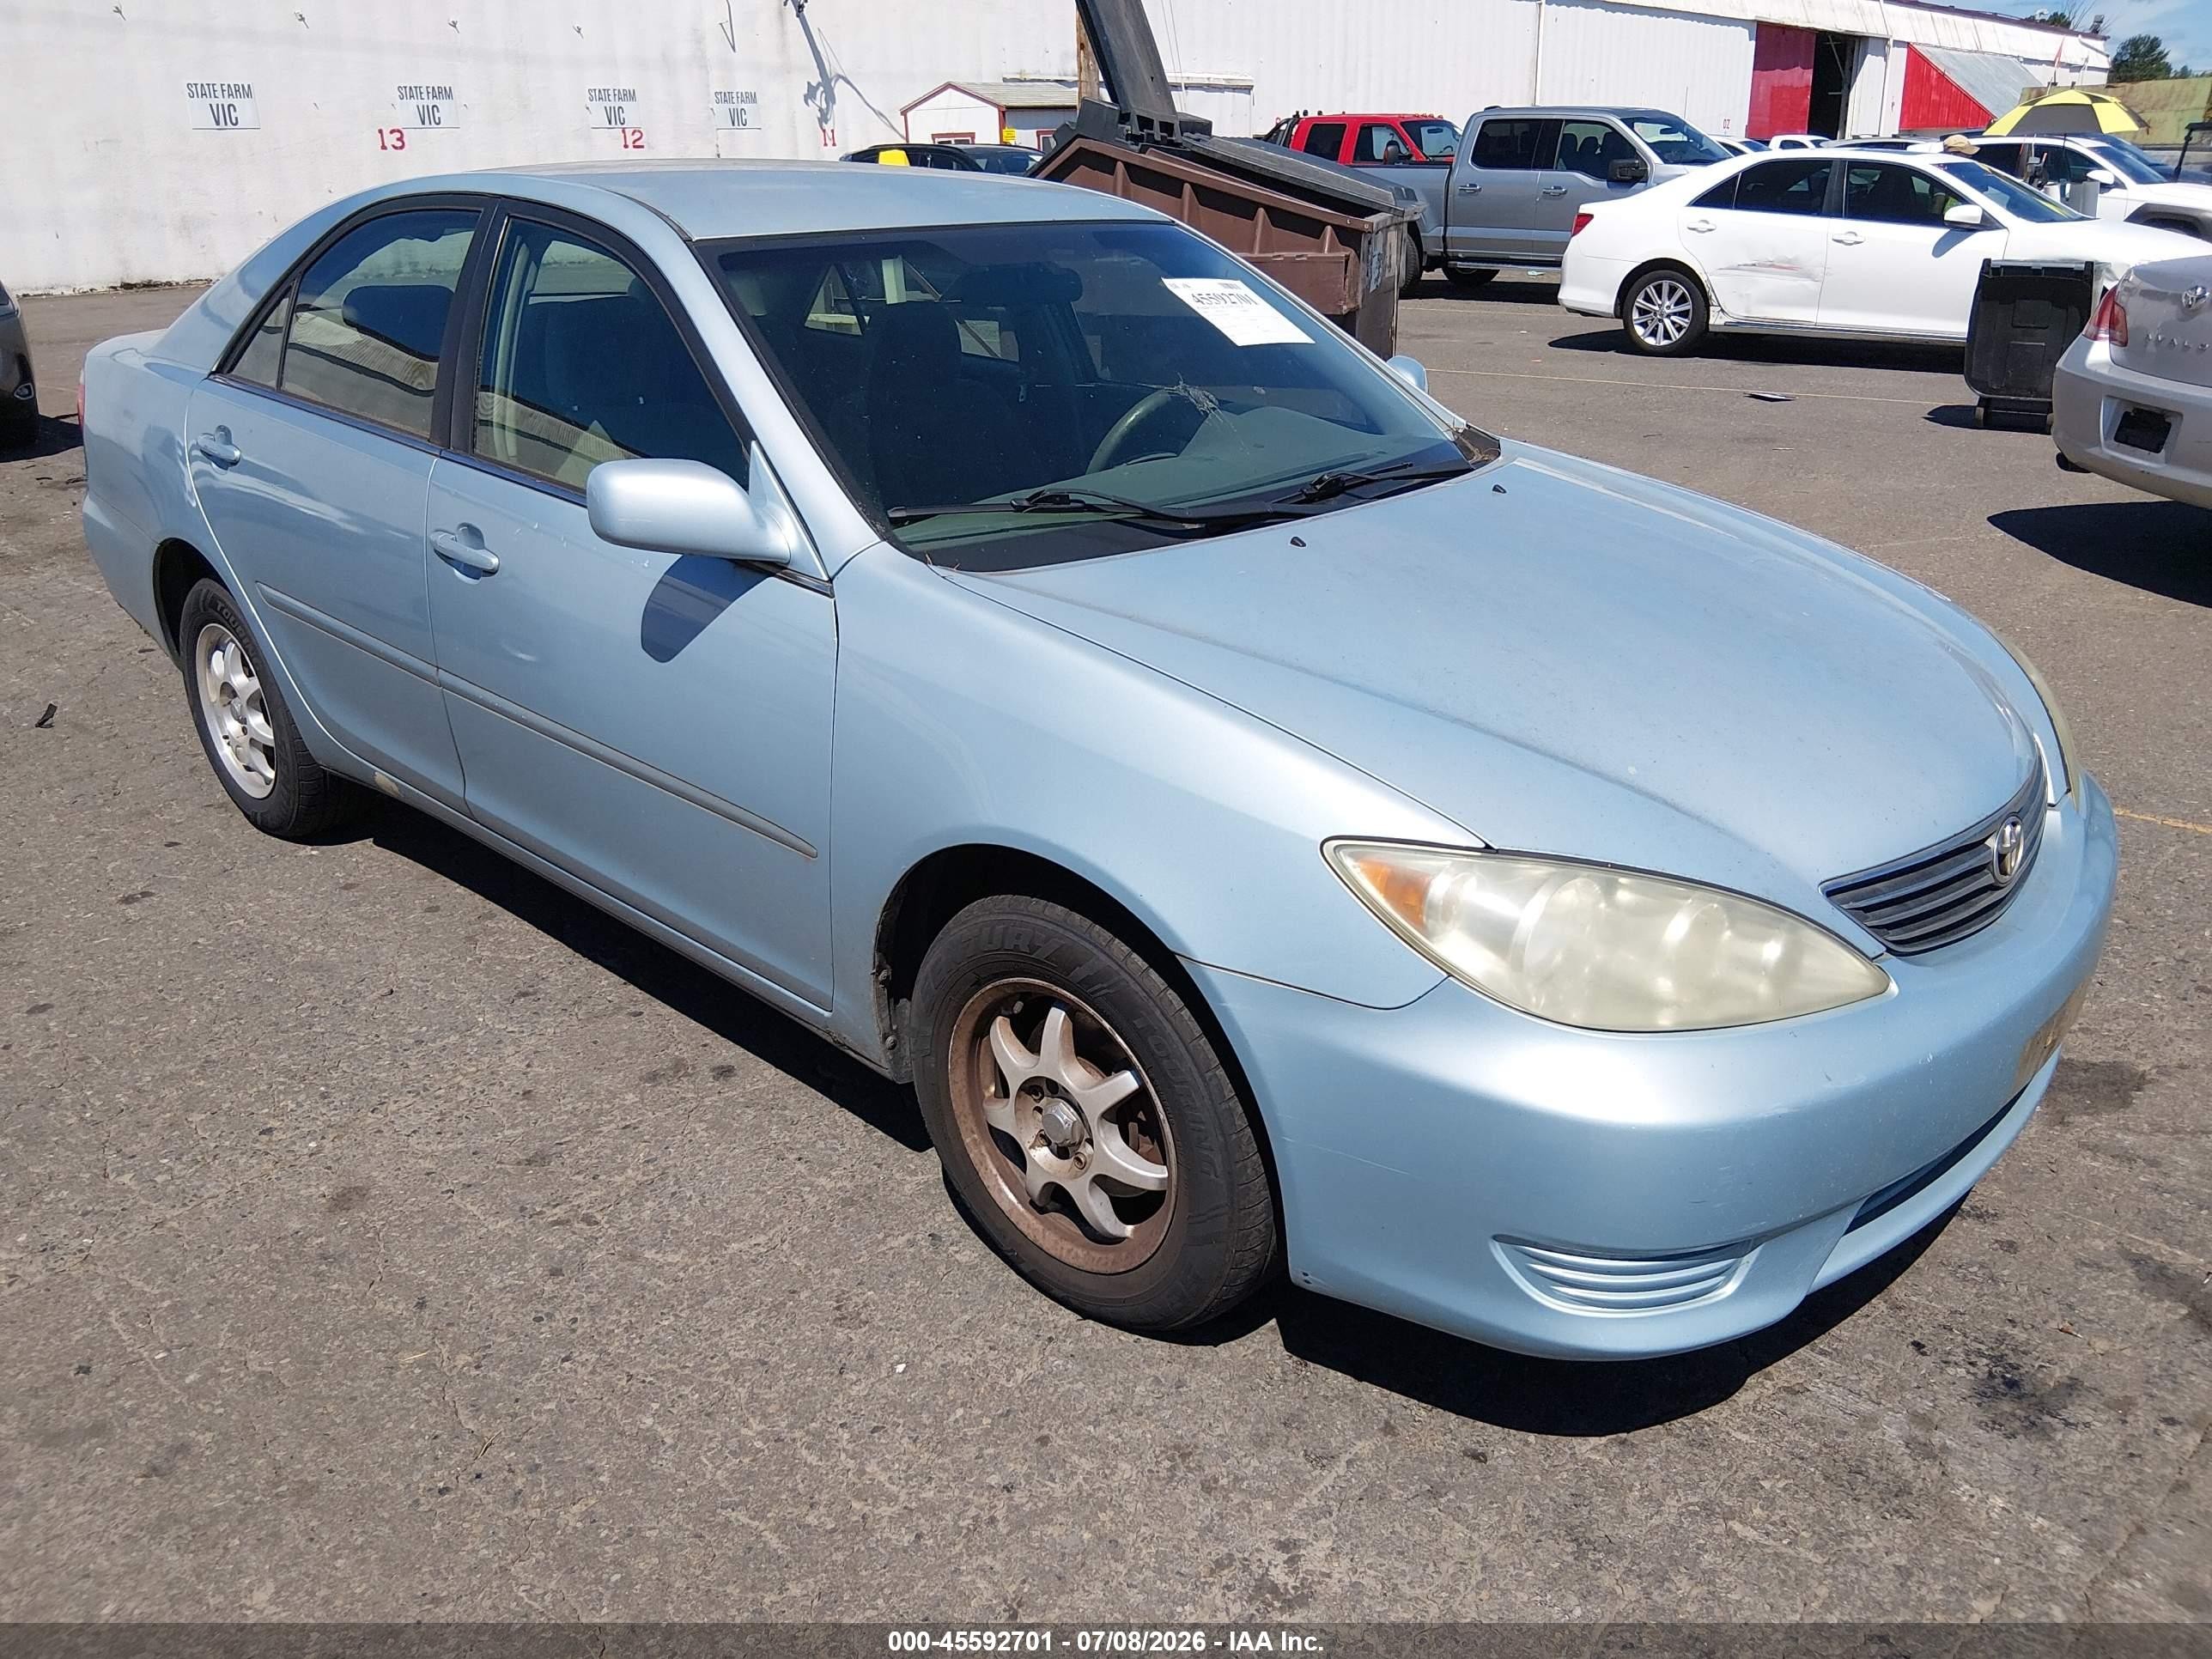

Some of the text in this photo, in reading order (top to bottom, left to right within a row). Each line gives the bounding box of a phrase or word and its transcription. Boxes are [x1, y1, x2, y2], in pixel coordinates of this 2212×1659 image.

[186, 82, 253, 99] STATE FARM
[398, 86, 453, 100] STATE FARM
[588, 88, 636, 102] STATE FARM
[714, 91, 757, 105] STATE FARM
[210, 103, 239, 126] VIC
[416, 105, 441, 125] VIC
[604, 106, 626, 125] VIC
[729, 107, 748, 127] VIC
[377, 128, 406, 150] 13
[622, 128, 645, 149] 12
[821, 128, 836, 147] 11
